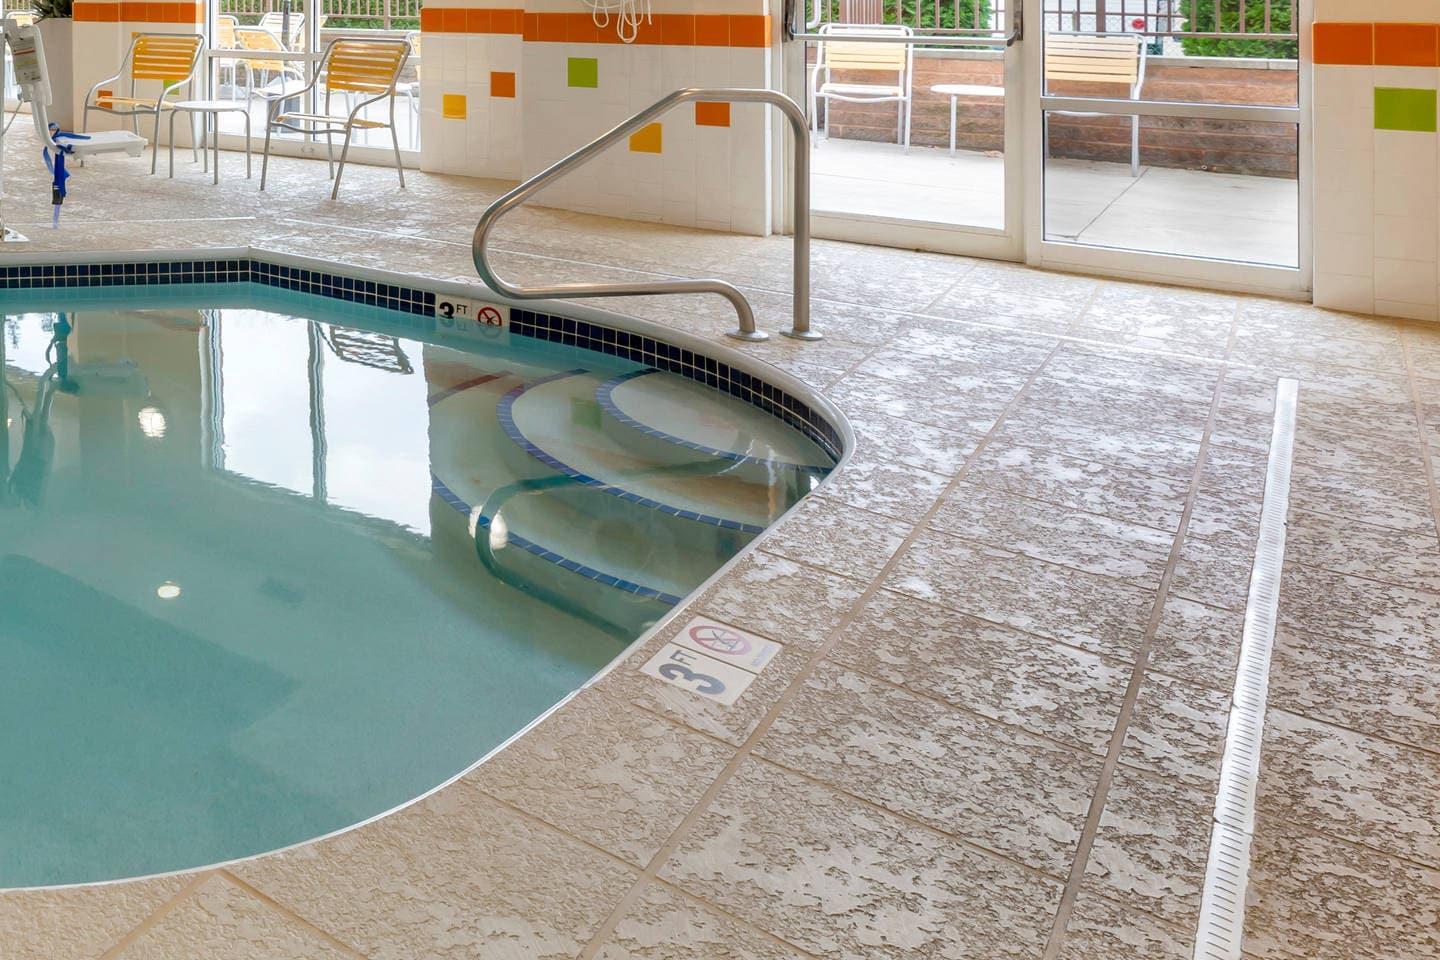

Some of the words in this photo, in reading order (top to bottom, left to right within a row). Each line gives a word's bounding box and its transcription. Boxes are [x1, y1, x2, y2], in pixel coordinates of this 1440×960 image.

[439, 301, 455, 319] 3
[456, 303, 468, 315] FT
[669, 649, 697, 667] FT
[658, 663, 727, 696] 3
